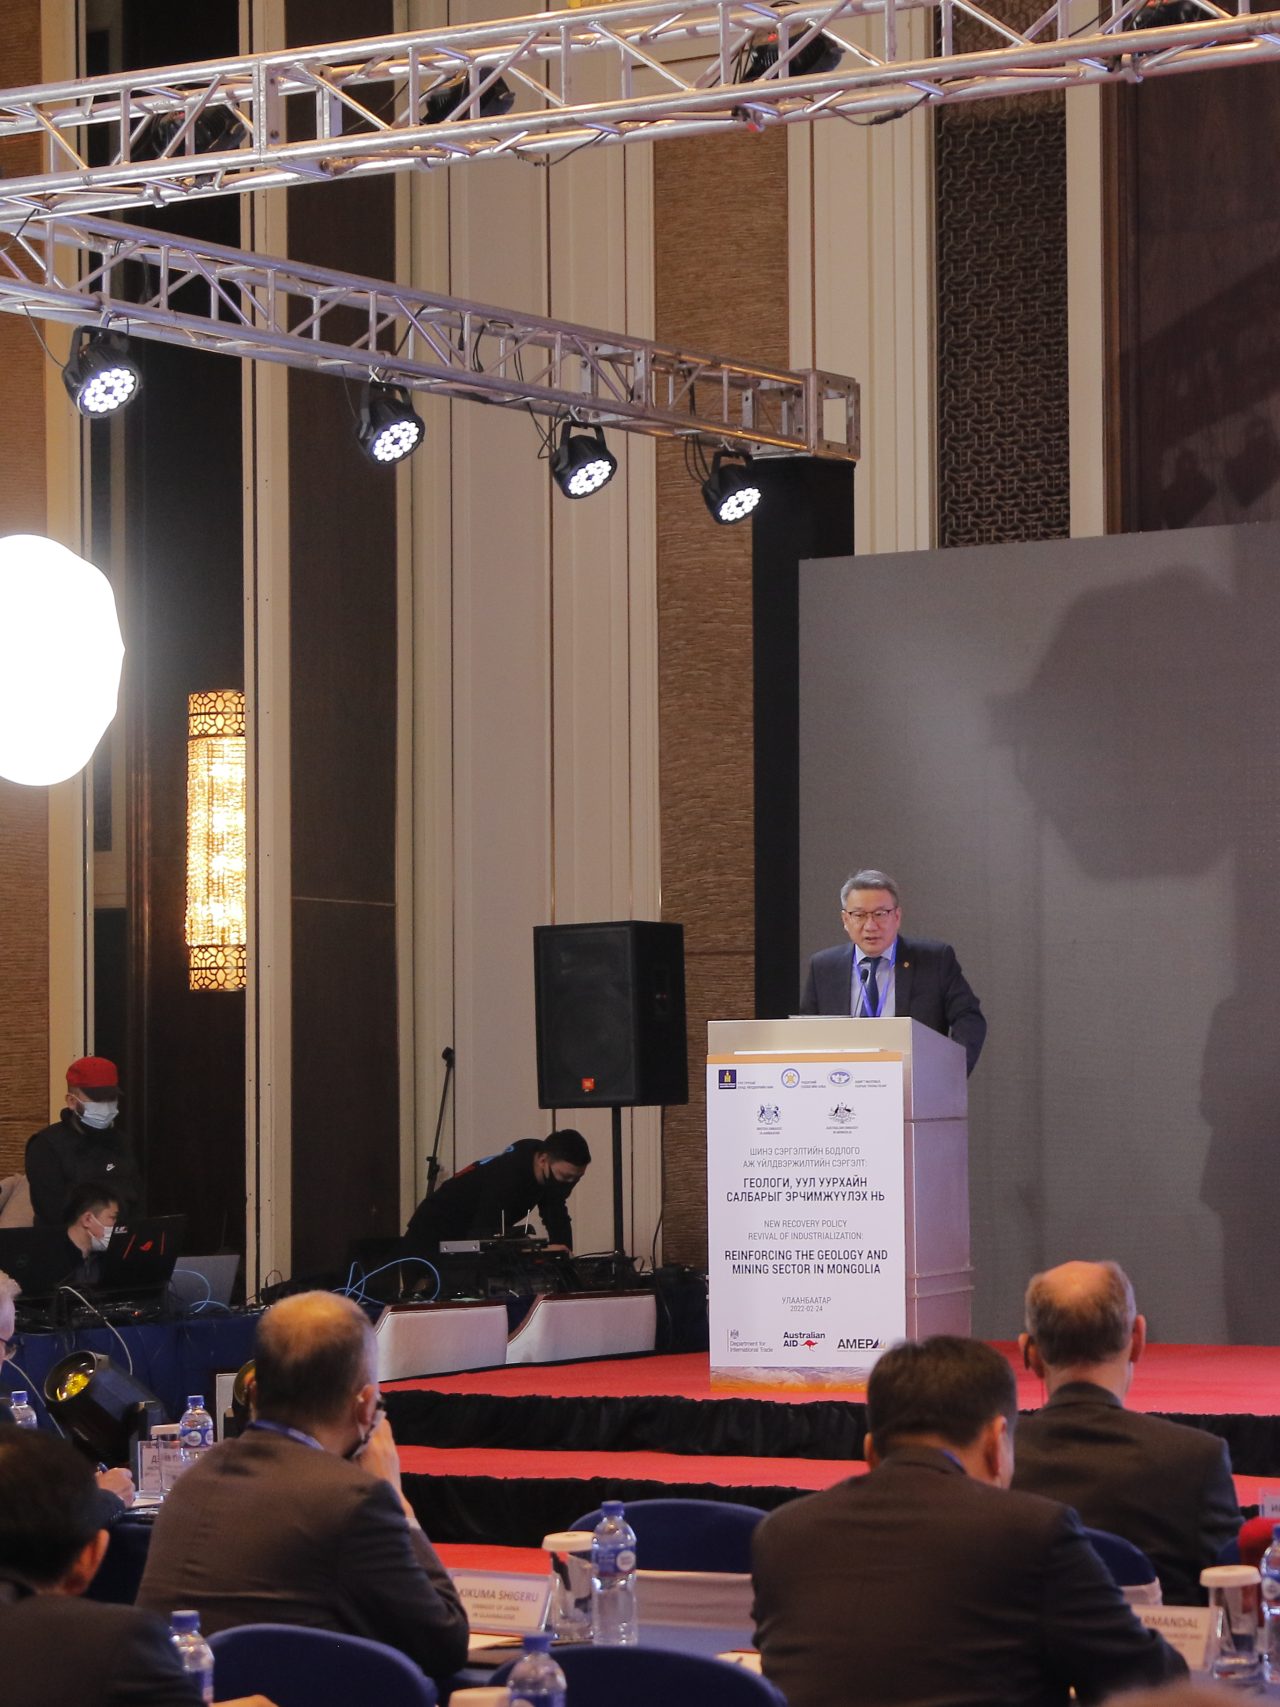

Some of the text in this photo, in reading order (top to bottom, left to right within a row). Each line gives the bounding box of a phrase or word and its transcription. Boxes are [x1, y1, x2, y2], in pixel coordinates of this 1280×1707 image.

[750, 1145, 860, 1157] ШИНЭ СЭРГЭЛТИЙН БОДЛОГО
[743, 1160, 755, 1168] АЖ
[744, 1175, 867, 1189] ГЕОЛОГИ, УУЛ УУРХАЙН
[727, 1192, 782, 1202] САЛБАРЫГ
[871, 1191, 885, 1201] НЬ
[764, 1220, 847, 1228] NEW RECOVERY POLICY
[748, 1232, 776, 1241] REVIVAL
[779, 1232, 788, 1241] OF
[725, 1250, 887, 1260] REINFORCING THE GEOLOGY AND
[733, 1264, 880, 1274] MINING SECTOR IN MONGOLIA
[837, 1339, 873, 1348] AMEP
[498, 1590, 539, 1602] SHIGERU
